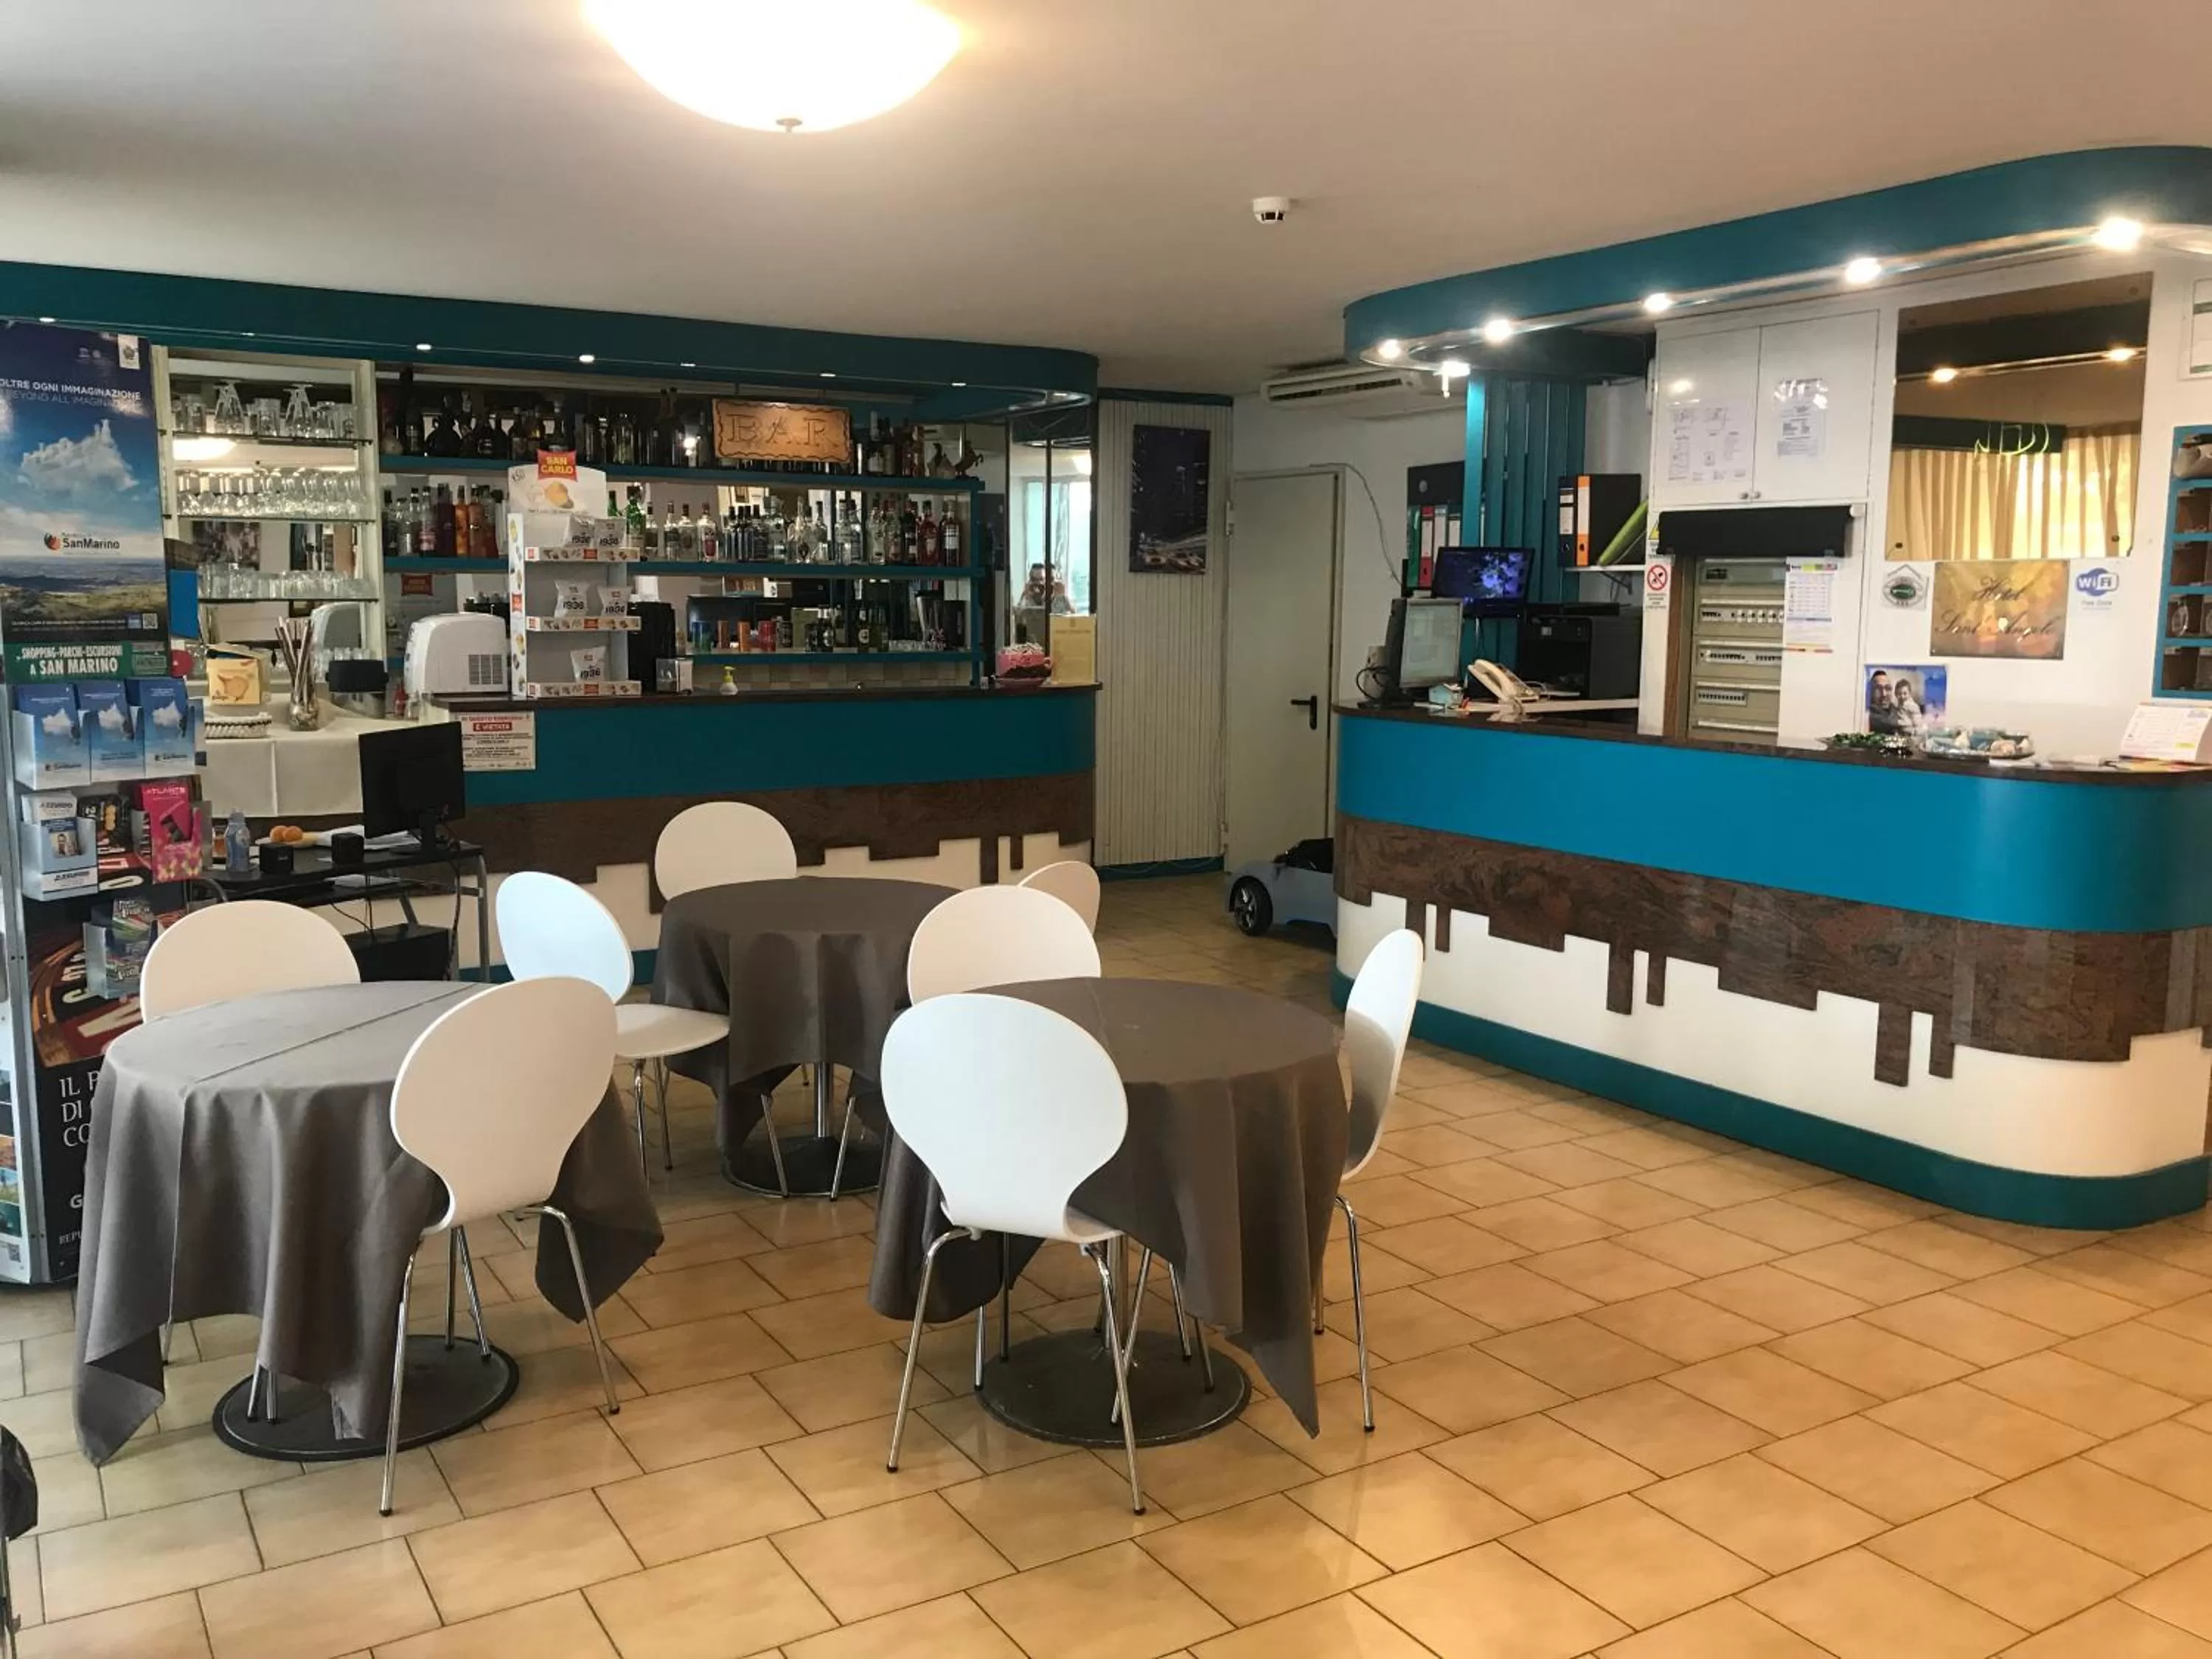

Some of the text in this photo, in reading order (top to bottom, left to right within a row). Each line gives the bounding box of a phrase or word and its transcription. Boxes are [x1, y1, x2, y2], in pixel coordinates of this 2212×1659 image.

[32, 381, 58, 392] OGNI
[61, 384, 142, 401] IMMAGINAZIONE
[51, 392, 69, 404] ALL
[726, 414, 838, 447] BAR
[540, 465, 574, 474] CARLO
[545, 456, 568, 465] SAN
[29, 664, 36, 675] A
[39, 659, 64, 675] SAN
[67, 657, 118, 674] MARINO
[59, 1076, 80, 1098] IL
[60, 1099, 83, 1123] DI
[63, 1123, 91, 1147] CO
[69, 1193, 83, 1208] G
